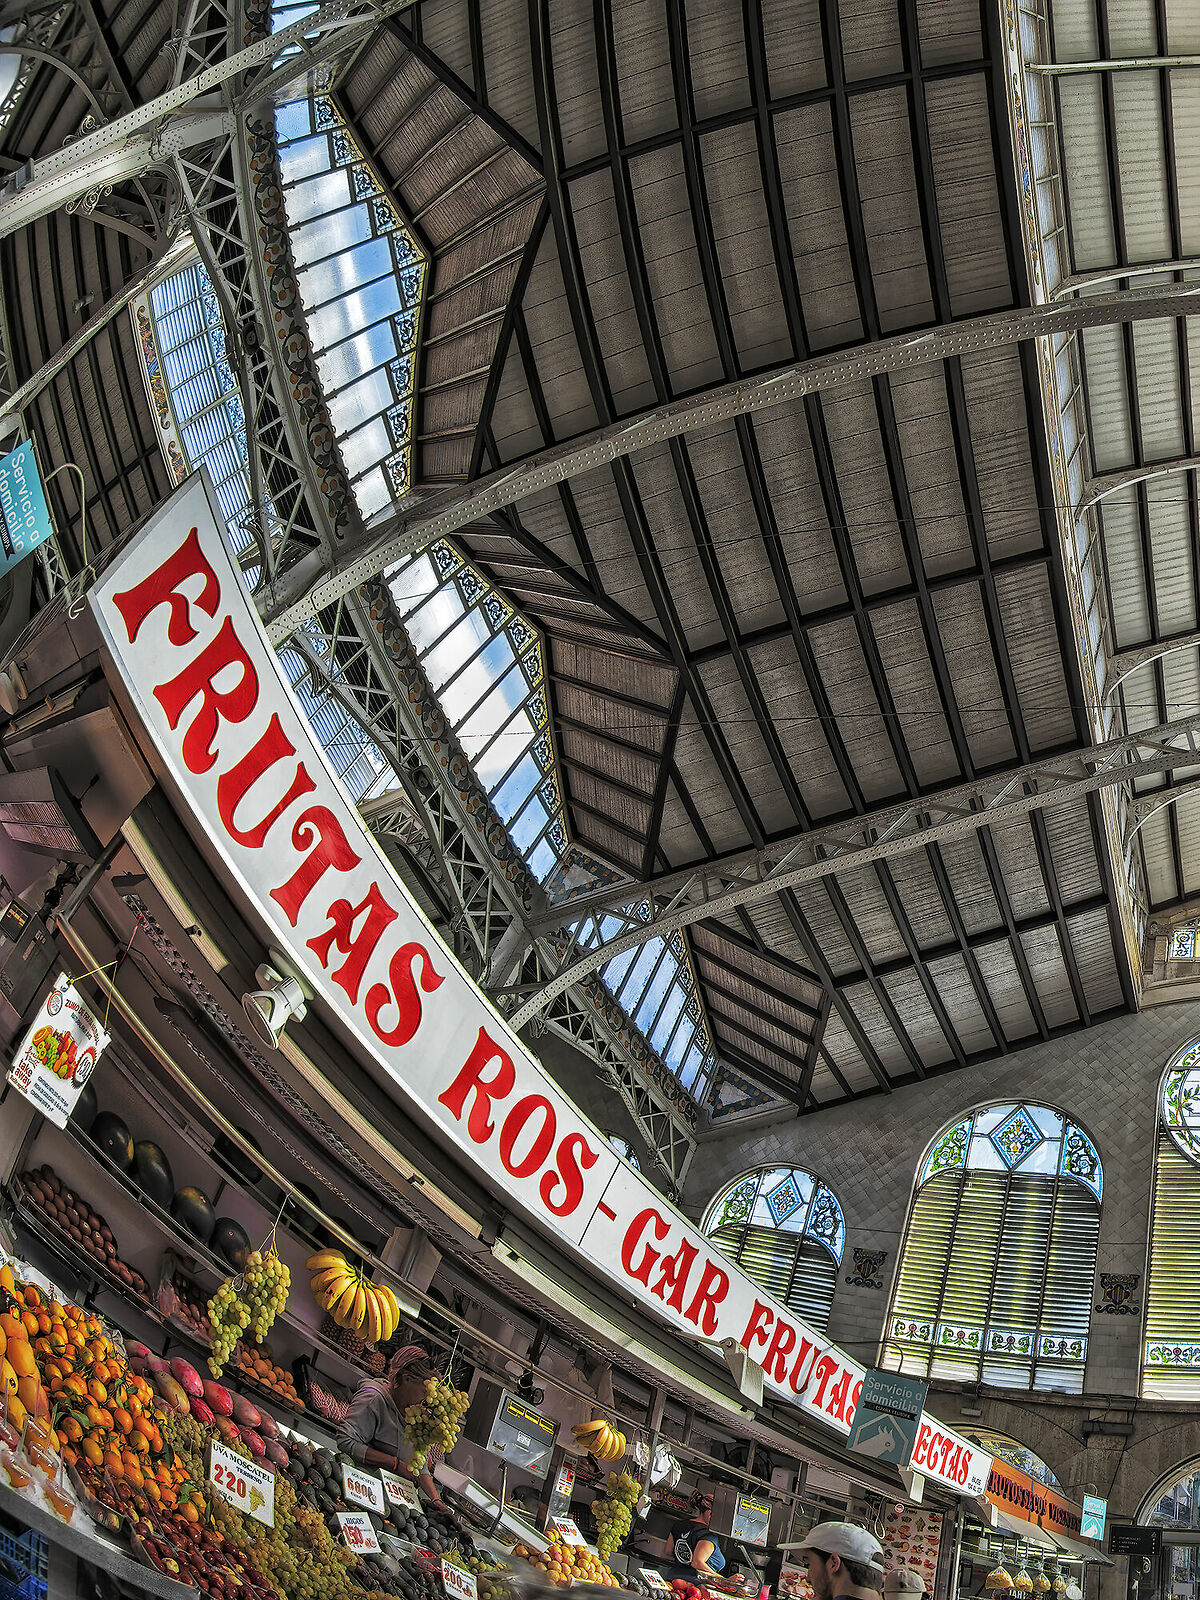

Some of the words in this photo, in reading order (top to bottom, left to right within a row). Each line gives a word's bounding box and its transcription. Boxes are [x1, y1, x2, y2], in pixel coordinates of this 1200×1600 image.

[11, 452, 37, 528] Servicio
[30, 529, 40, 543] a
[113, 528, 445, 1048] FRUTAS
[438, 1094, 599, 1217] ROS
[621, 1208, 730, 1337] GAR
[740, 1298, 863, 1428] FRUTAS
[912, 1422, 974, 1486] ECTAS
[14, 1067, 32, 1089] away
[18, 1057, 33, 1078] take
[865, 1390, 918, 1414] domicilio
[866, 1376, 913, 1400] Servicio
[915, 1392, 923, 1401] a
[213, 1443, 228, 1458] UVA
[230, 1454, 273, 1484] MOSCATEL
[988, 1469, 1023, 1507] RUTOS
